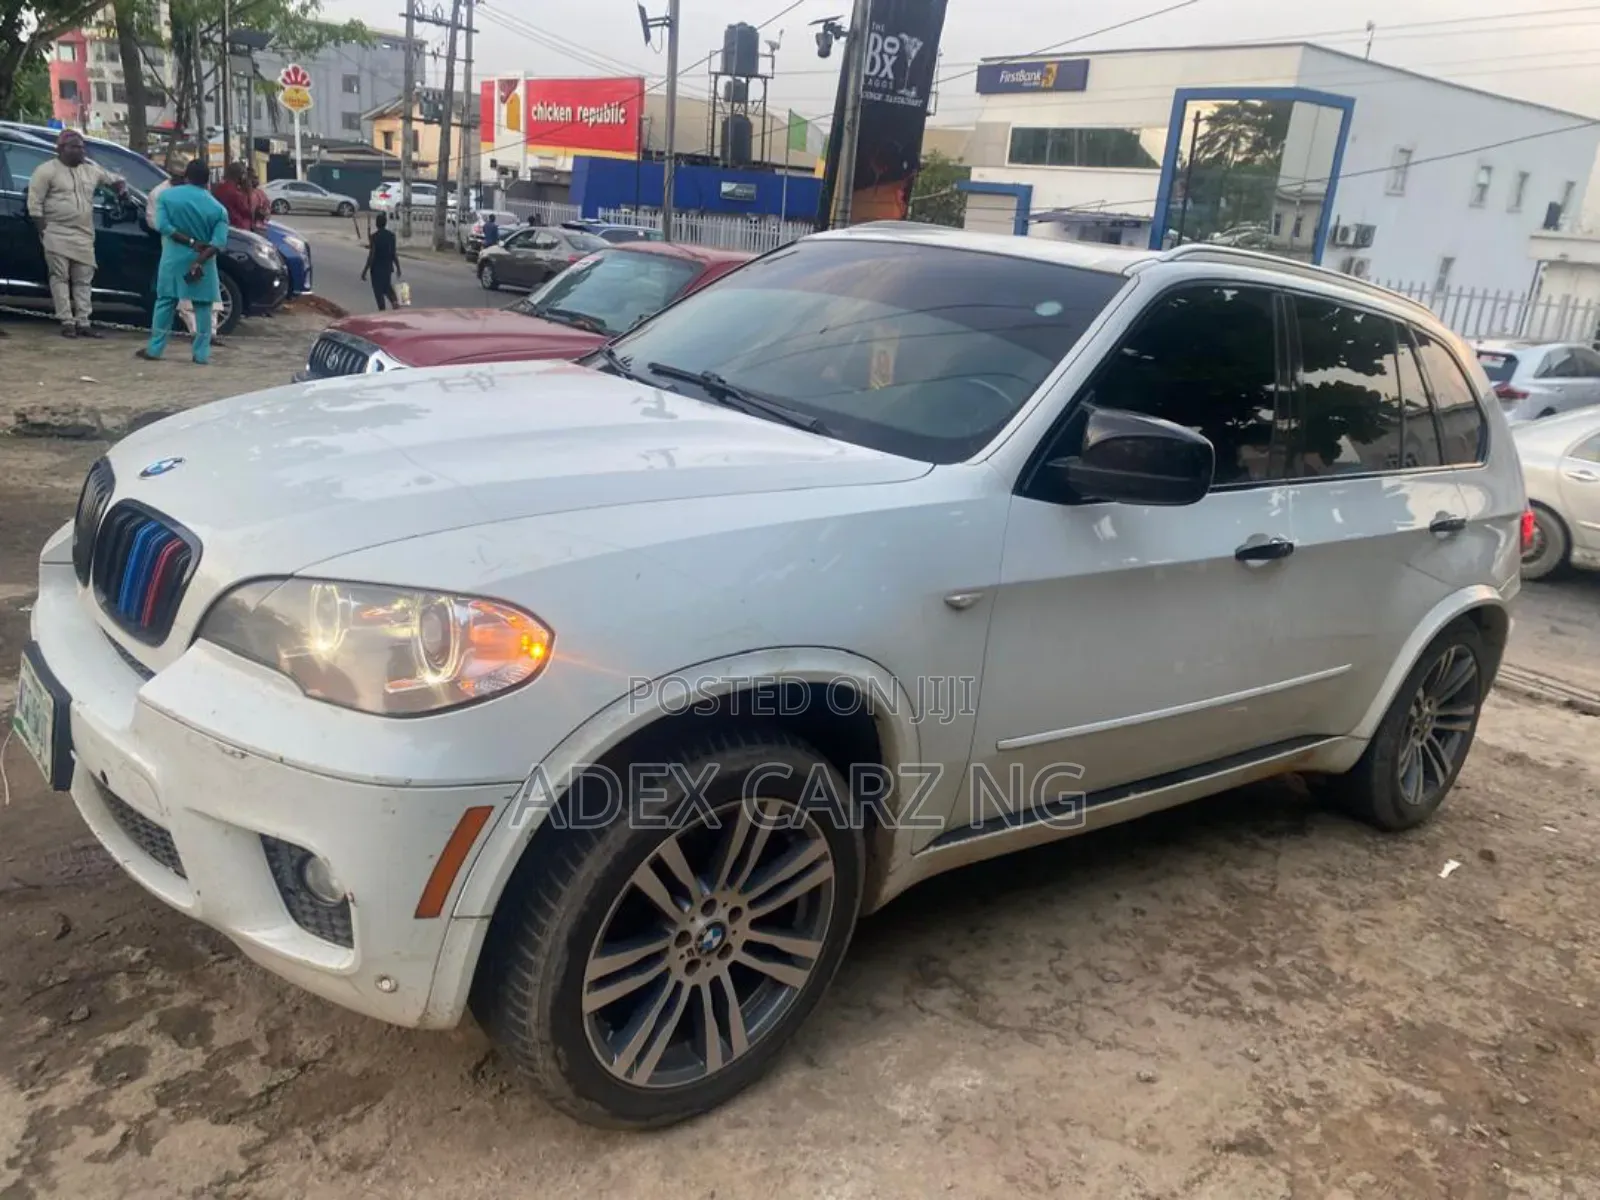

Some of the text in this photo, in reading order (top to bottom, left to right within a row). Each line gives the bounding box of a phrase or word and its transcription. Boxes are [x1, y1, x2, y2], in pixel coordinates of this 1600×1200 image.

[865, 31, 900, 80] BOX
[1000, 68, 1042, 84] FirstBank
[531, 100, 627, 129] chicken republic
